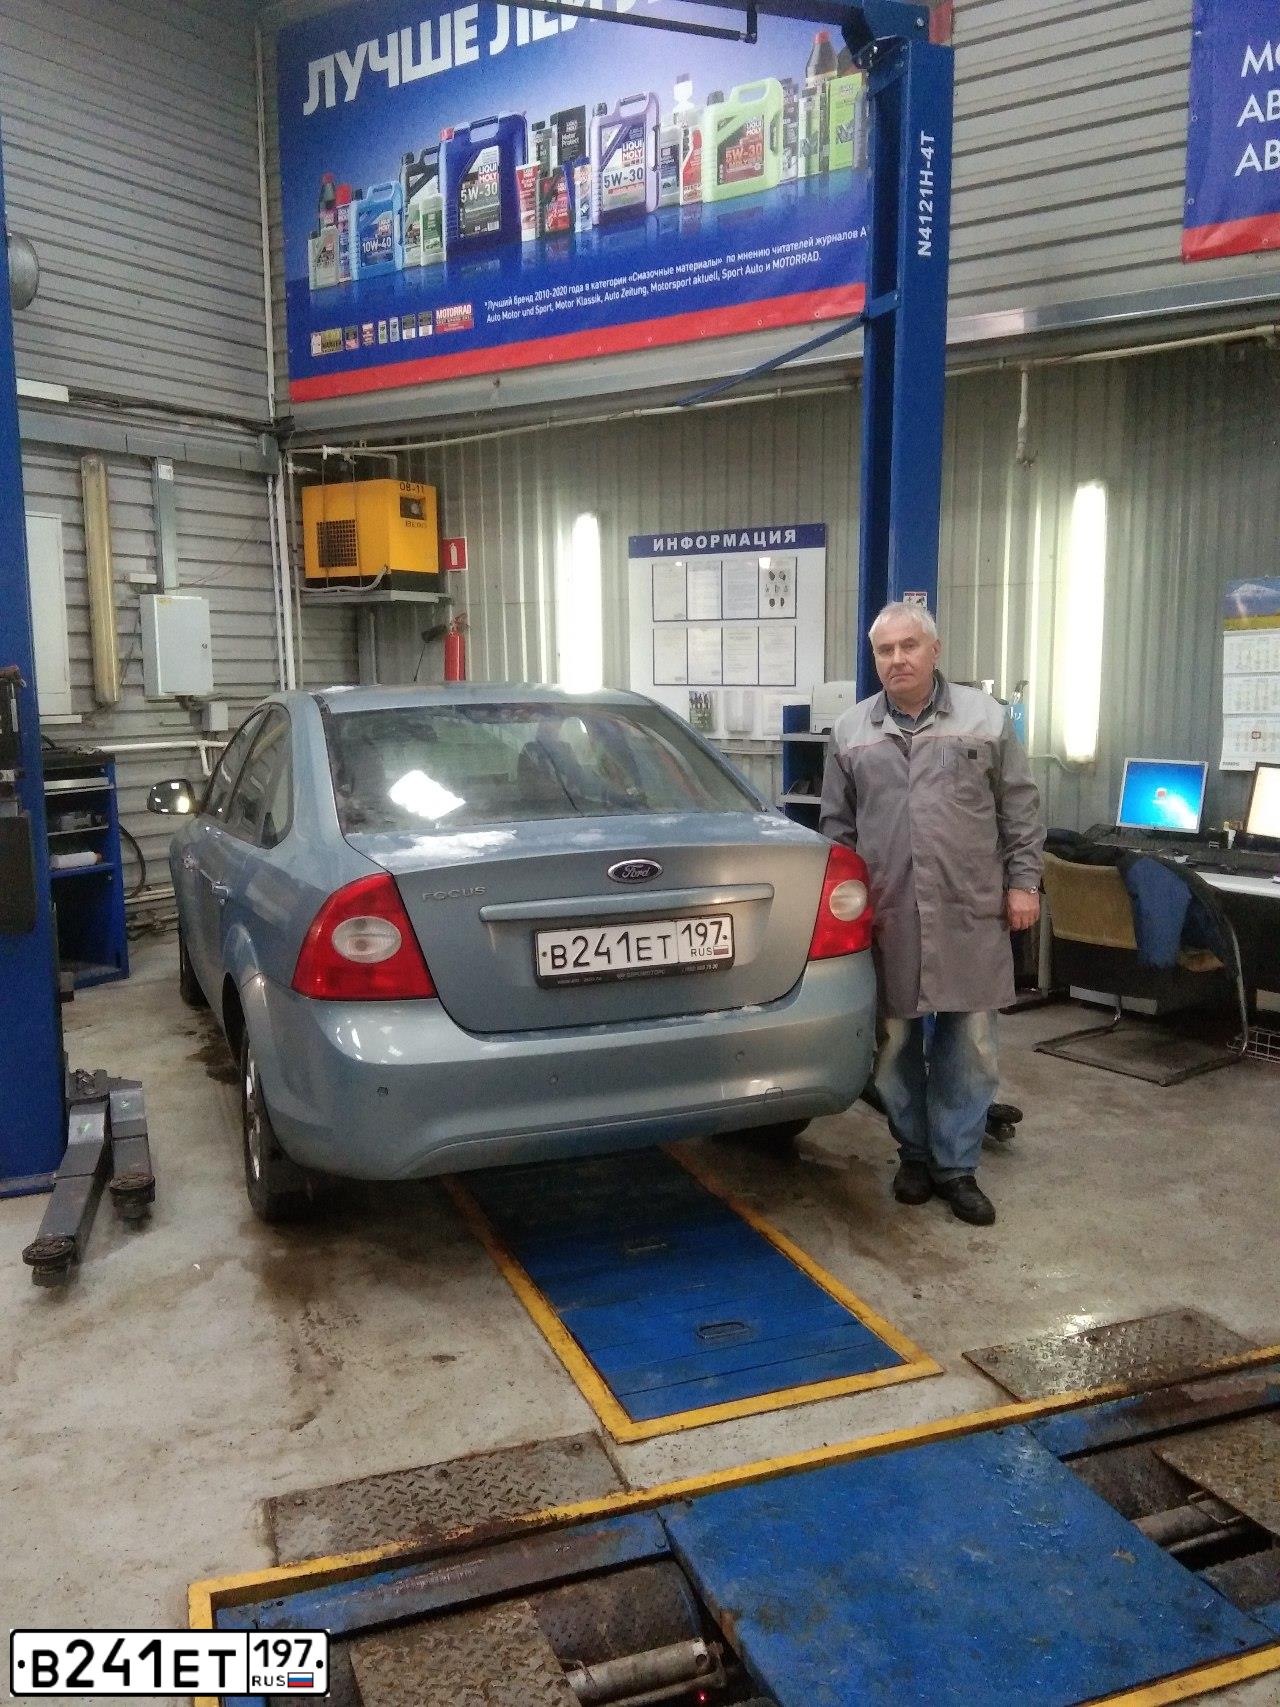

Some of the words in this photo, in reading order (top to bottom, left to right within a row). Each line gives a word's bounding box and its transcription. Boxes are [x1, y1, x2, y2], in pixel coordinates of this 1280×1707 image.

[303, 3, 480, 116] ЛУЧШЕ
[1240, 40, 1280, 78] М
[621, 139, 645, 153] LIQUI
[622, 147, 645, 161] MOLY
[478, 162, 498, 176] LIQUI
[479, 171, 498, 184] MOLY
[603, 166, 644, 190] 5W-30
[460, 182, 499, 205] 5W-30
[917, 129, 935, 257] N4121H-4T
[362, 236, 392, 253] 10W-40
[514, 294, 534, 307] бренд
[535, 286, 568, 301] 2010-2020
[569, 284, 584, 296] года
[591, 276, 627, 292] категории
[628, 266, 675, 283] «Смазочные
[676, 257, 723, 274] материалы»
[726, 253, 736, 264] по
[737, 247, 771, 262] мнению
[772, 235, 815, 254] читателей
[815, 230, 859, 247] журналов
[487, 312, 501, 324] Auto
[502, 310, 521, 322] Motor
[521, 306, 535, 318] und
[535, 302, 555, 316] Sport,
[555, 299, 574, 311] Motor
[576, 294, 603, 307] Klassik,
[604, 290, 620, 302] Auto
[620, 284, 649, 300] Zeitung,
[650, 276, 692, 294] Motorsport
[693, 270, 721, 284] aktuell,
[722, 266, 744, 281] Sport
[745, 263, 764, 275] Auto
[772, 251, 822, 269] MOTORRAD.
[436, 304, 472, 319] MOTORRAD
[653, 529, 797, 552] ИНФОРМАЦИЯ
[422, 886, 487, 901] FOCUS
[681, 920, 723, 948] 197
[690, 947, 713, 957] RUS
